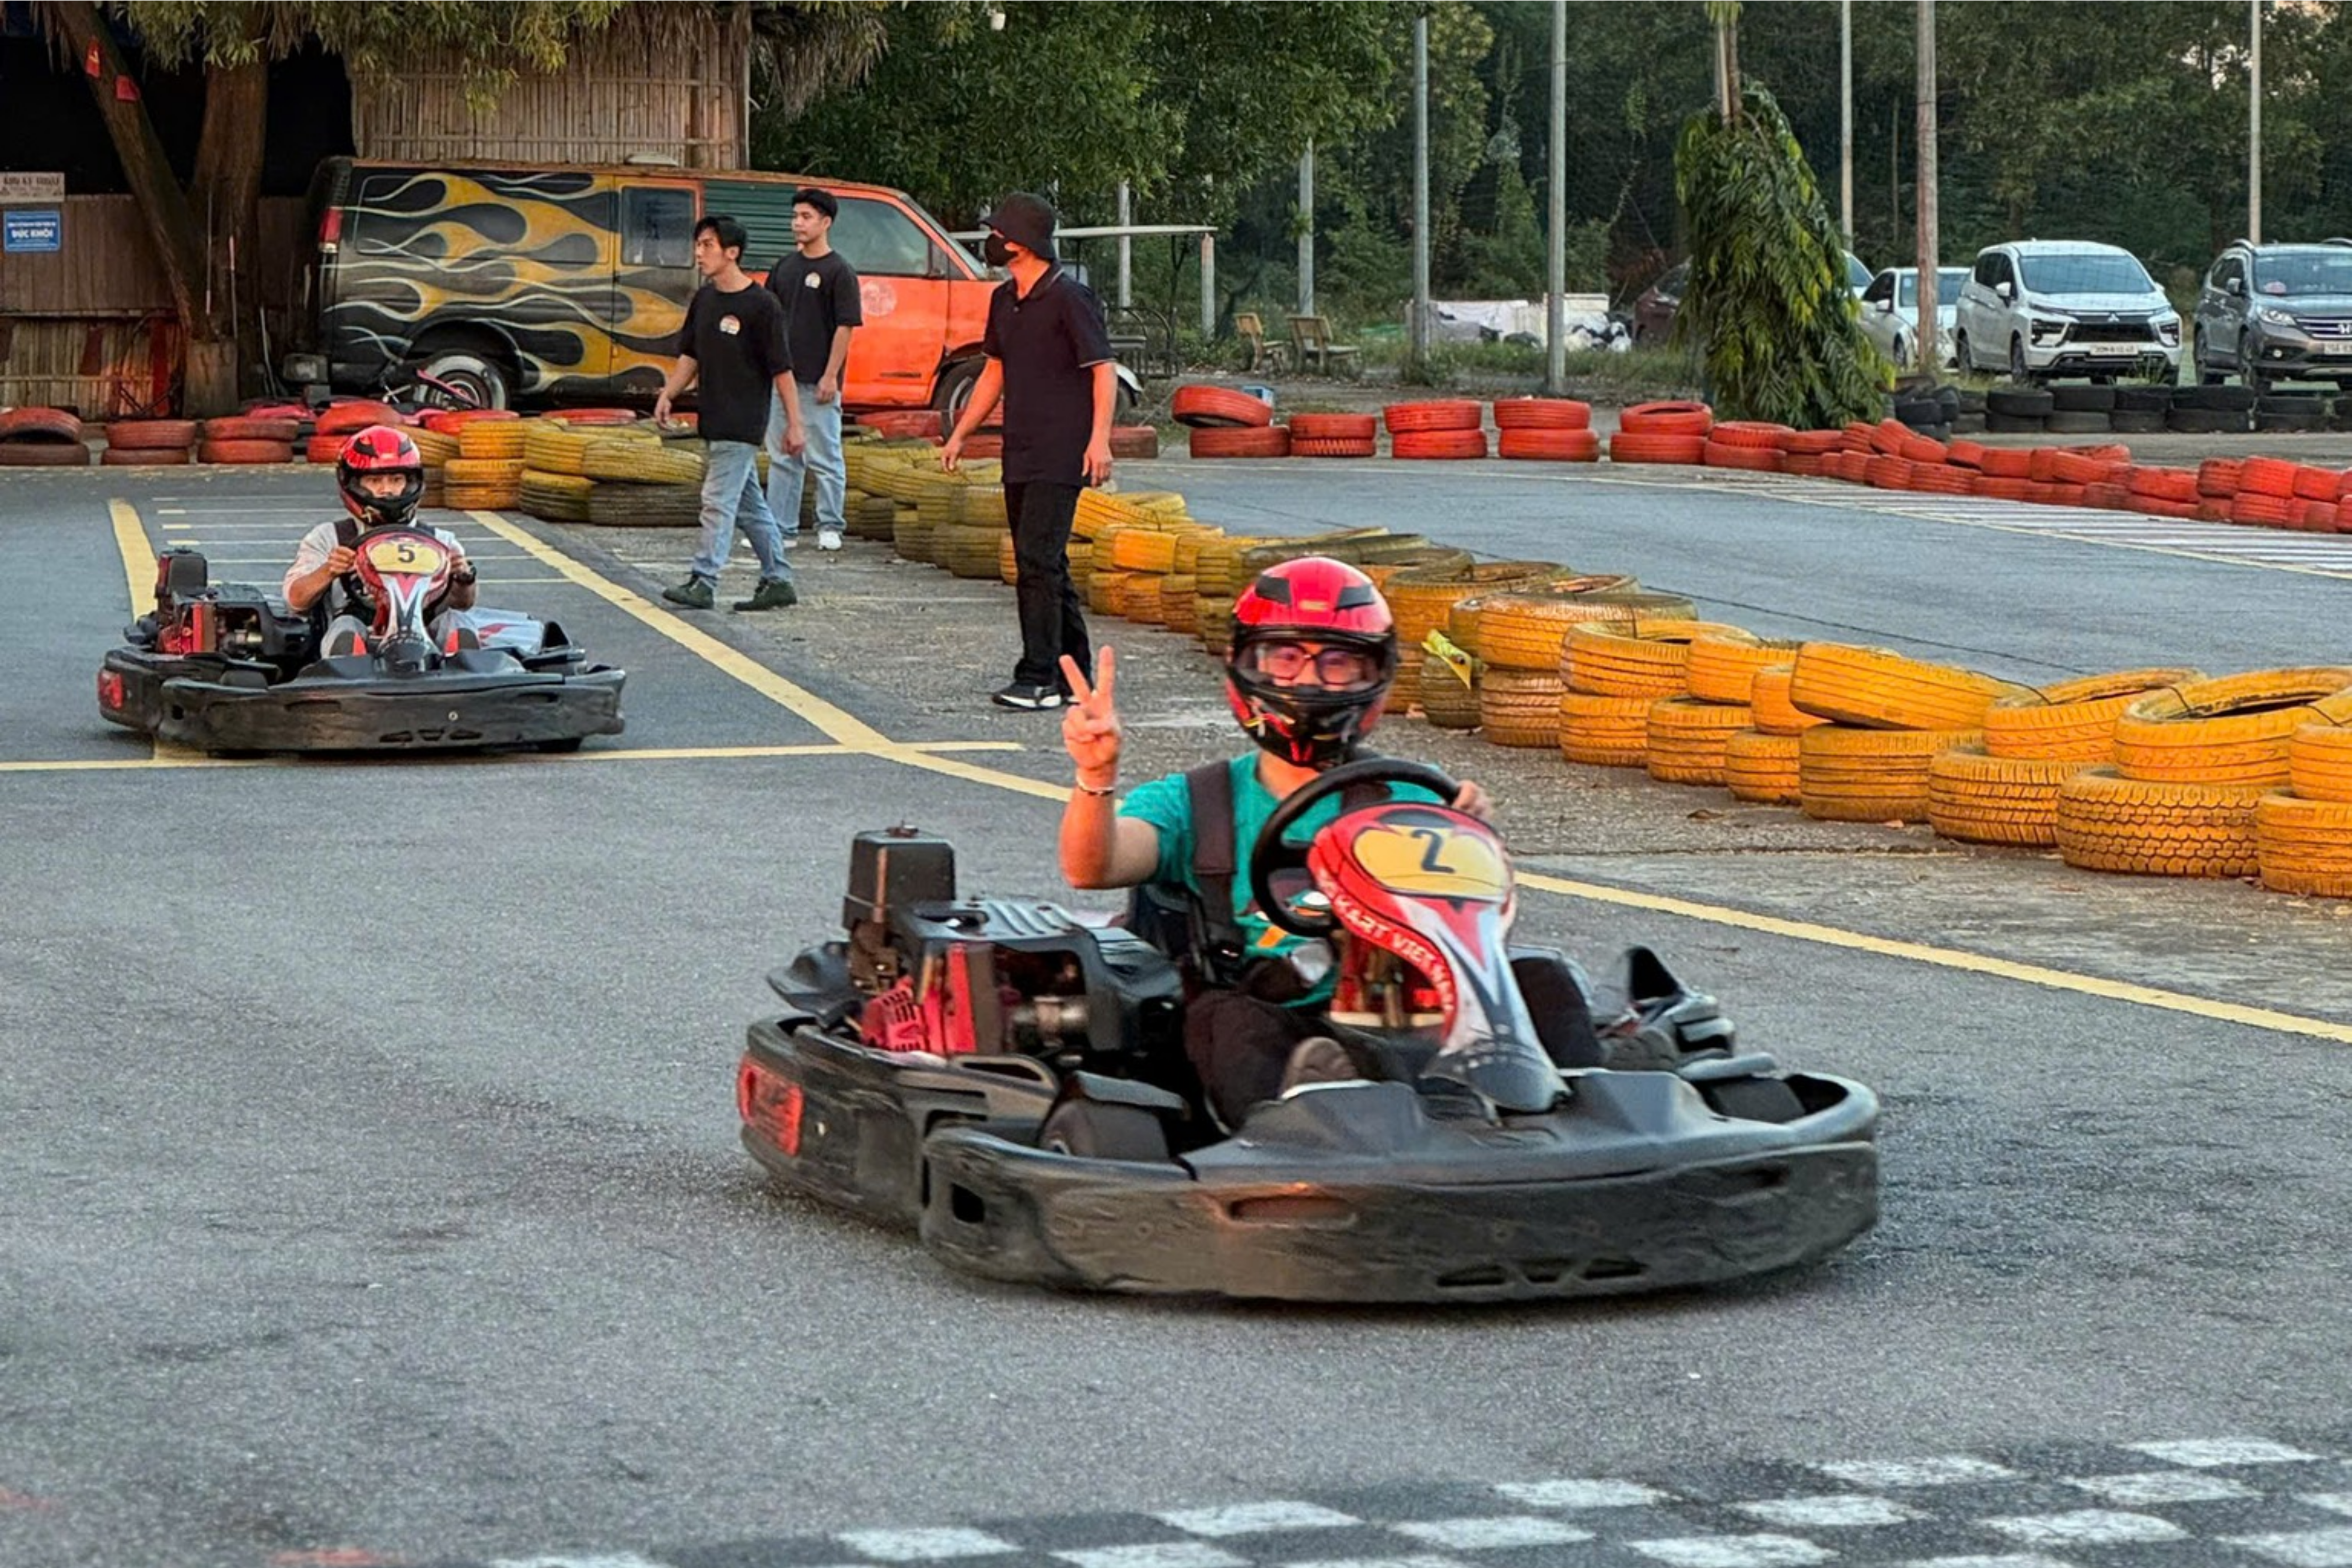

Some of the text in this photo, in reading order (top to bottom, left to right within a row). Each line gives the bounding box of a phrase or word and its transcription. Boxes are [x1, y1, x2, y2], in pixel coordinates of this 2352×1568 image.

[397, 543, 415, 563] 5
[1409, 829, 1456, 874] 2
[1334, 893, 1390, 938] KART
